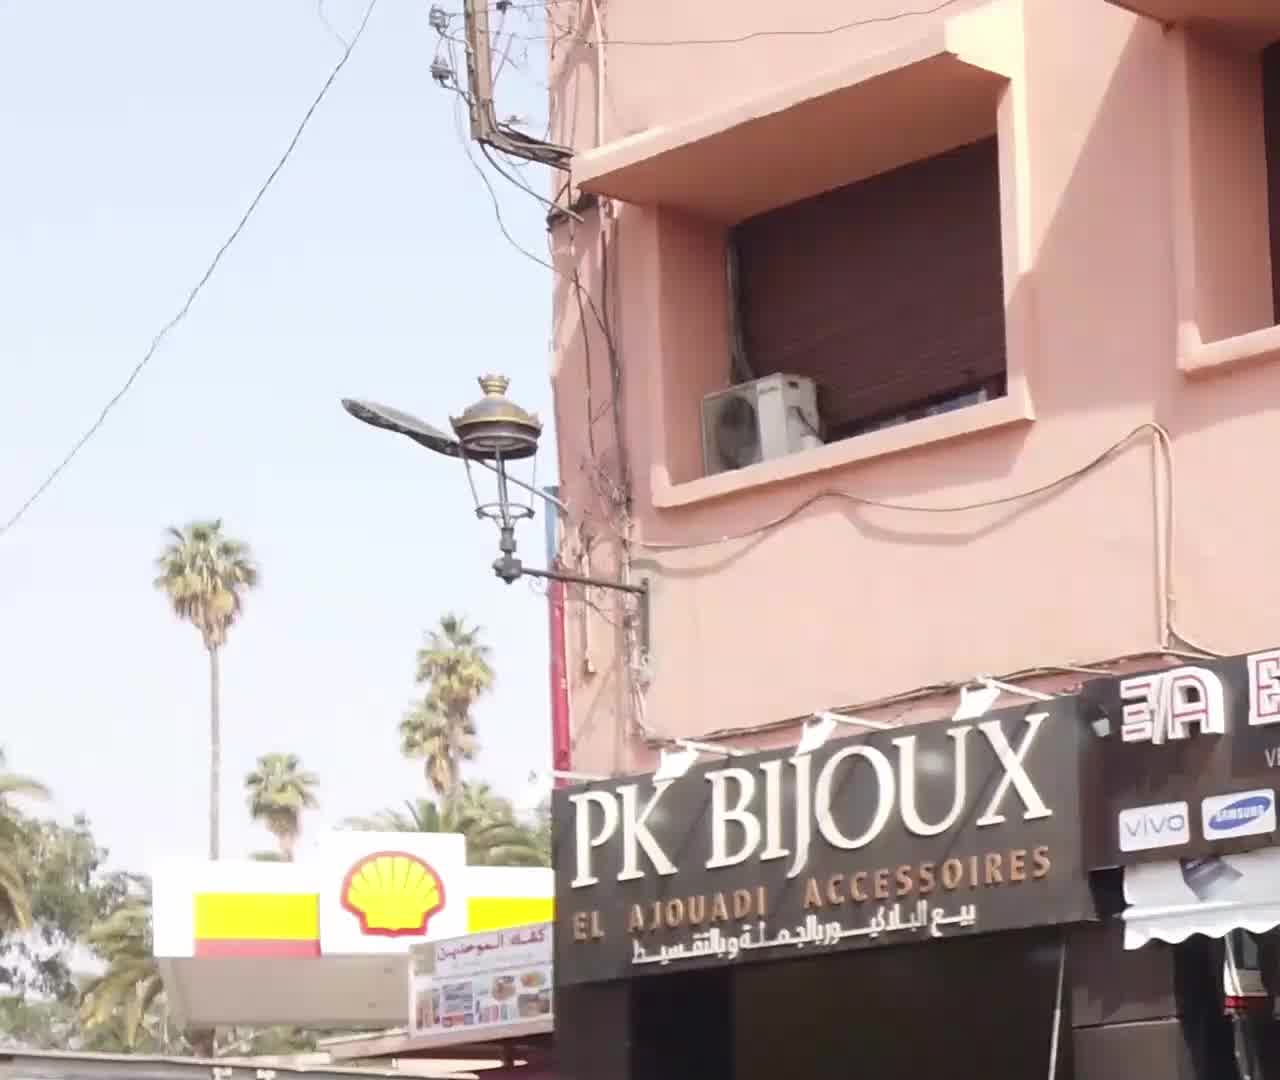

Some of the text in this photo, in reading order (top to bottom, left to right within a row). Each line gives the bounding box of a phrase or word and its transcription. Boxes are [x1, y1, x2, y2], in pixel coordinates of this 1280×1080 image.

[568, 713, 1053, 890] PK BIJOUX
[1125, 813, 1184, 837] vivo
[572, 846, 1051, 943] EL AJOUADI ACCESSOIRES
[930, 904, 976, 937] بيع
